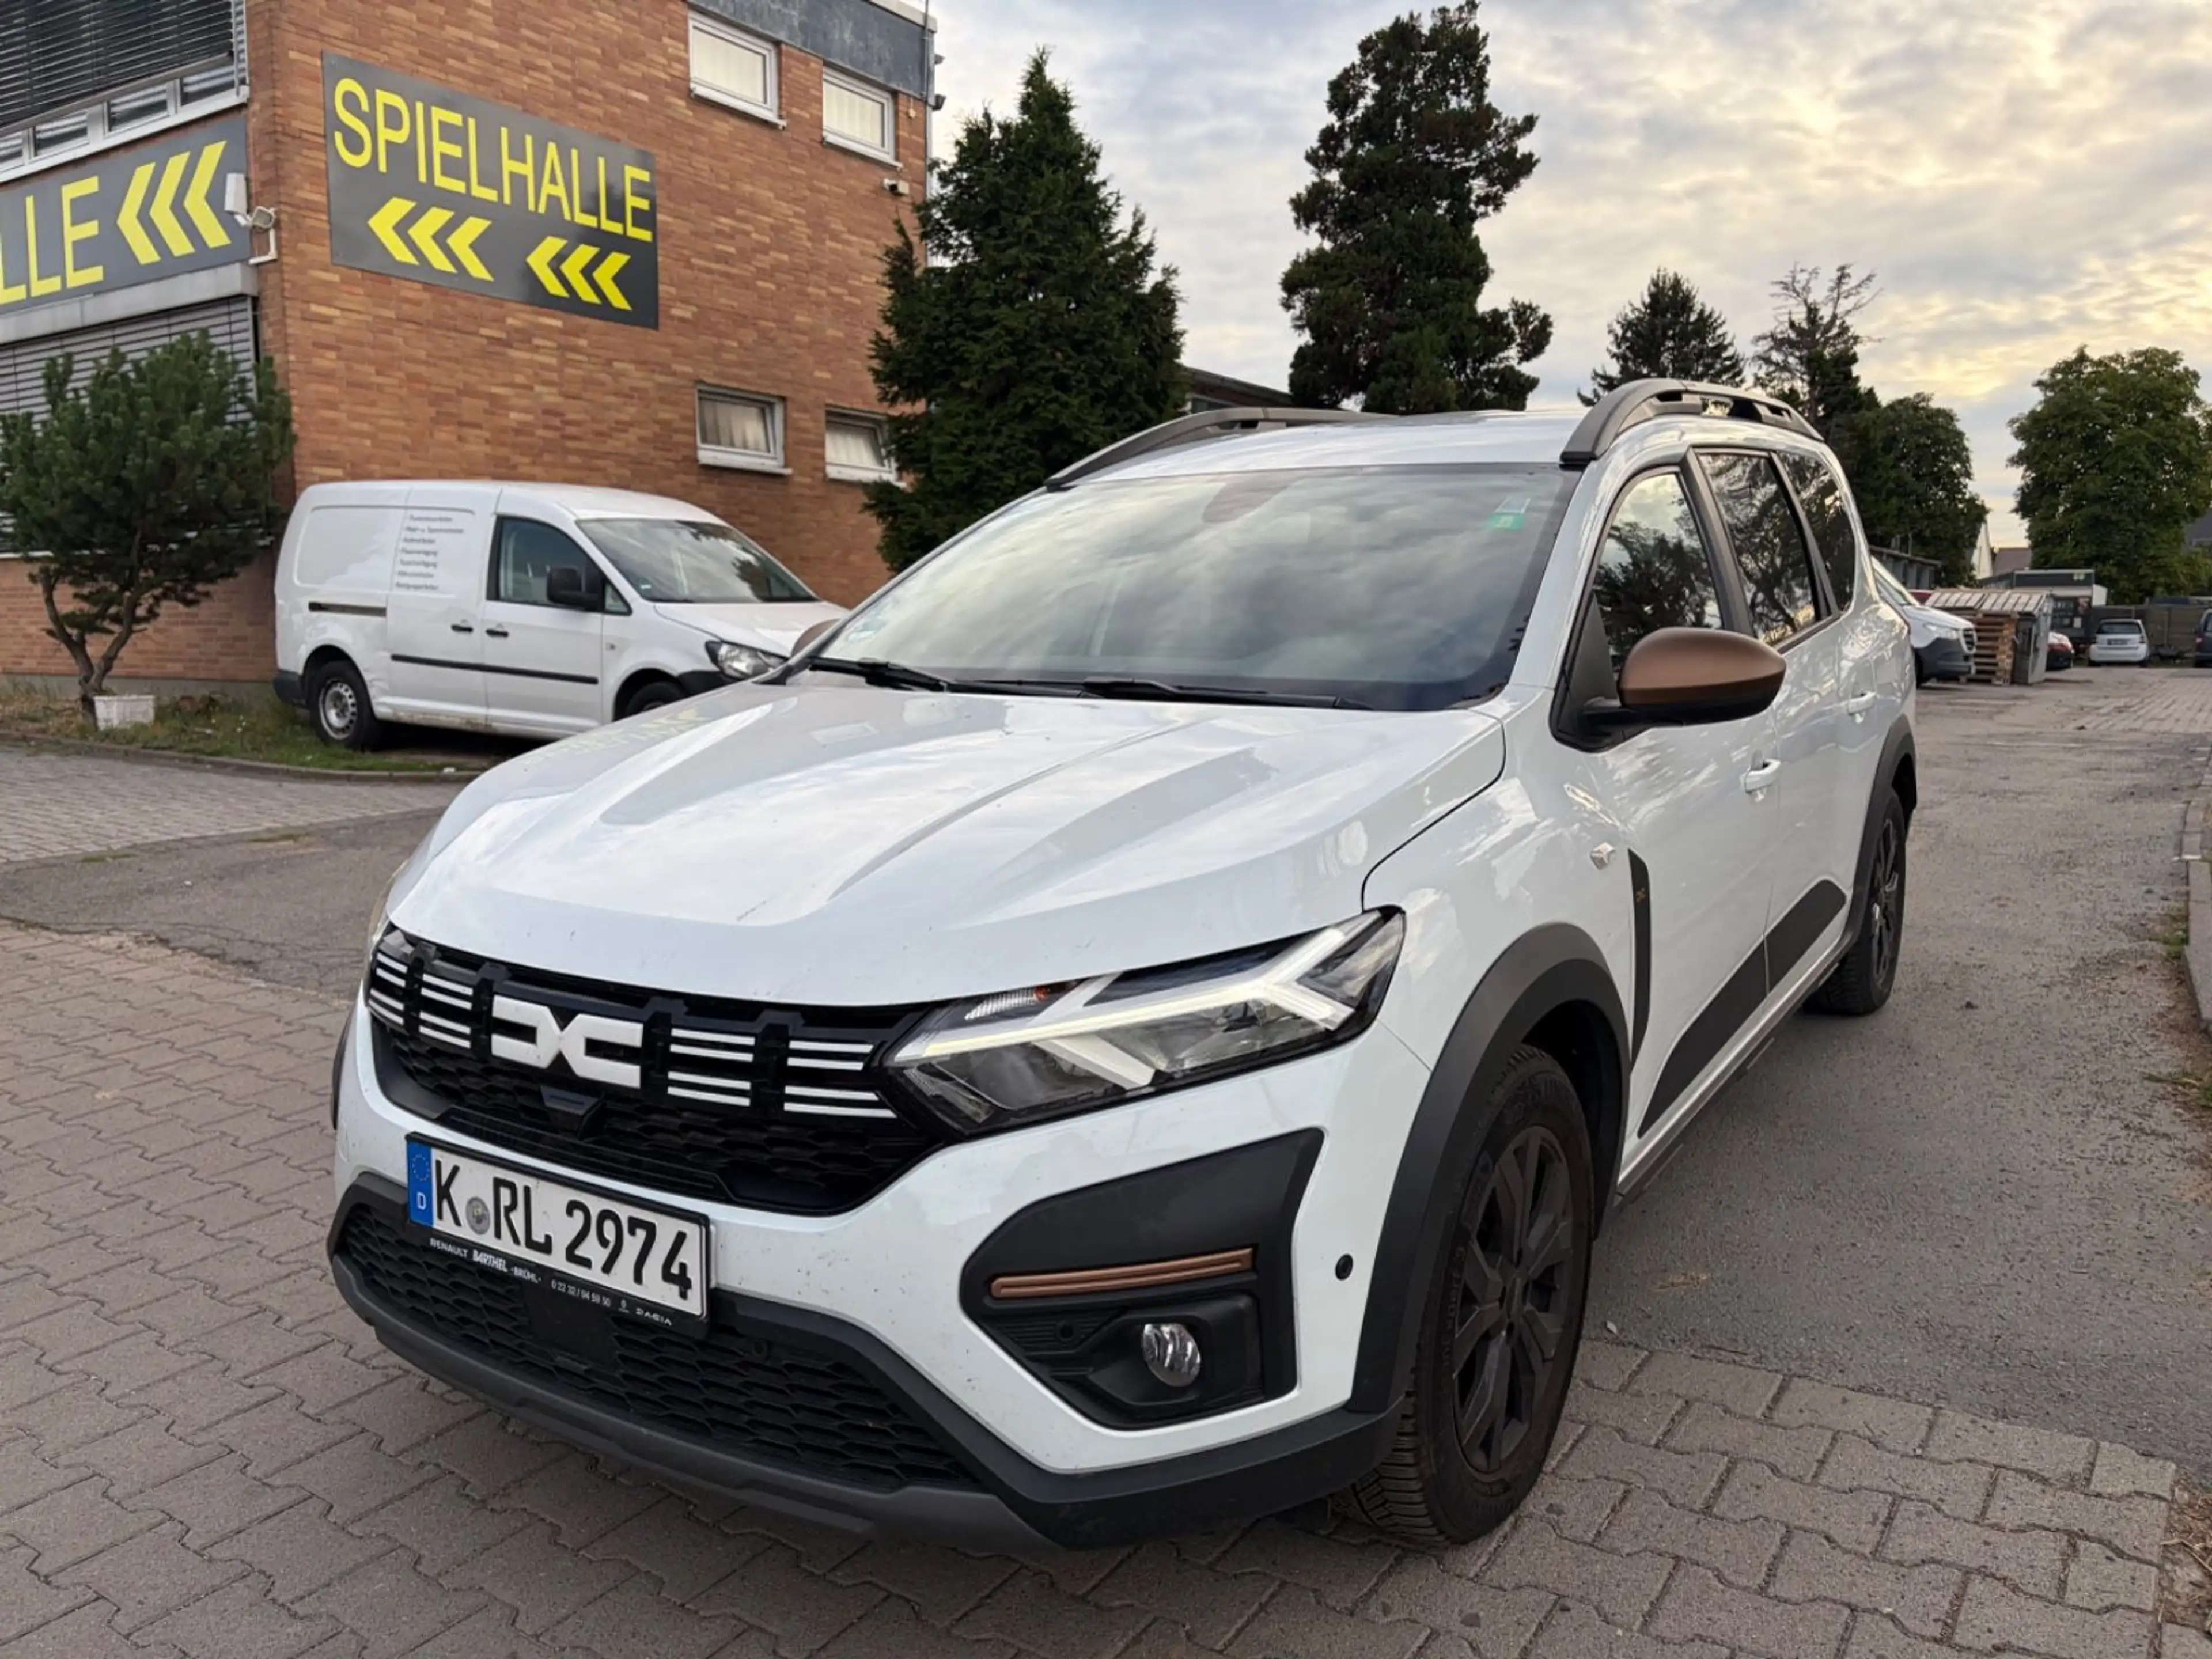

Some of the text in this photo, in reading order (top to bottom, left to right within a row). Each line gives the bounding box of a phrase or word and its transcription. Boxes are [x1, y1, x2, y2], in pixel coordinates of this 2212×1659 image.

[333, 78, 654, 243] SPIELHALLE
[416, 1191, 427, 1210] D
[435, 1158, 692, 1301] K RL 2974
[430, 1237, 468, 1259] RENAULT
